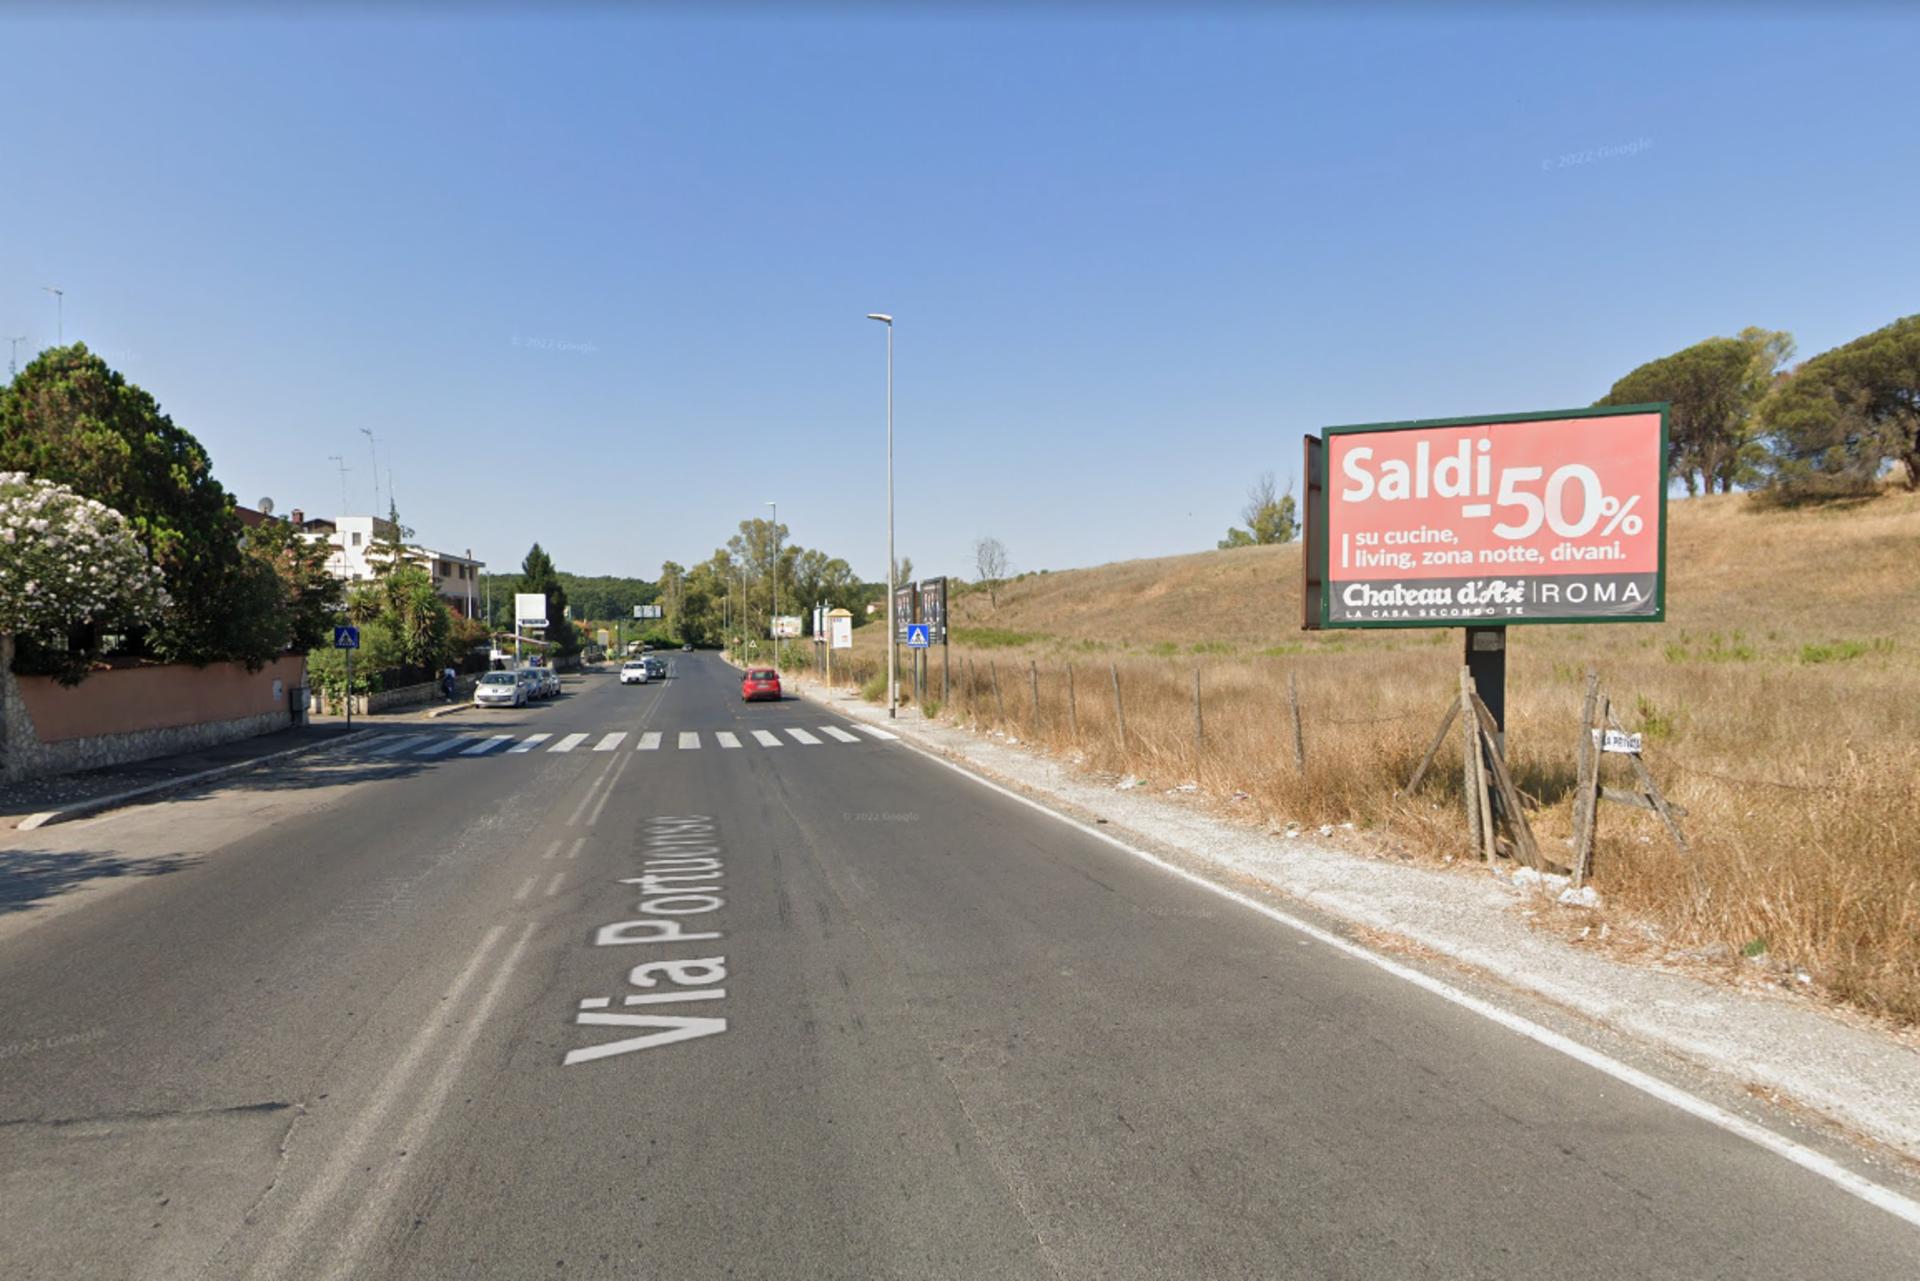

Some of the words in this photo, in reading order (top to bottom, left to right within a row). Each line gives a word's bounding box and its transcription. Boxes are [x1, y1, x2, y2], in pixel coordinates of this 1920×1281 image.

[1342, 438, 1492, 502] Saldi
[1462, 464, 1644, 540] -50%
[1355, 532, 1379, 546] su
[1384, 526, 1459, 545] cucine,
[1355, 550, 1417, 569] living,
[1422, 551, 1473, 566] zona
[1479, 545, 1545, 565] notte,
[1551, 541, 1626, 562] divani.
[1342, 583, 1452, 607] Chateau
[1541, 582, 1642, 603] ROMA
[1346, 610, 1362, 618] LA
[1372, 609, 1410, 618] CASA
[1505, 606, 1524, 615] TE
[562, 955, 727, 1066] Via
